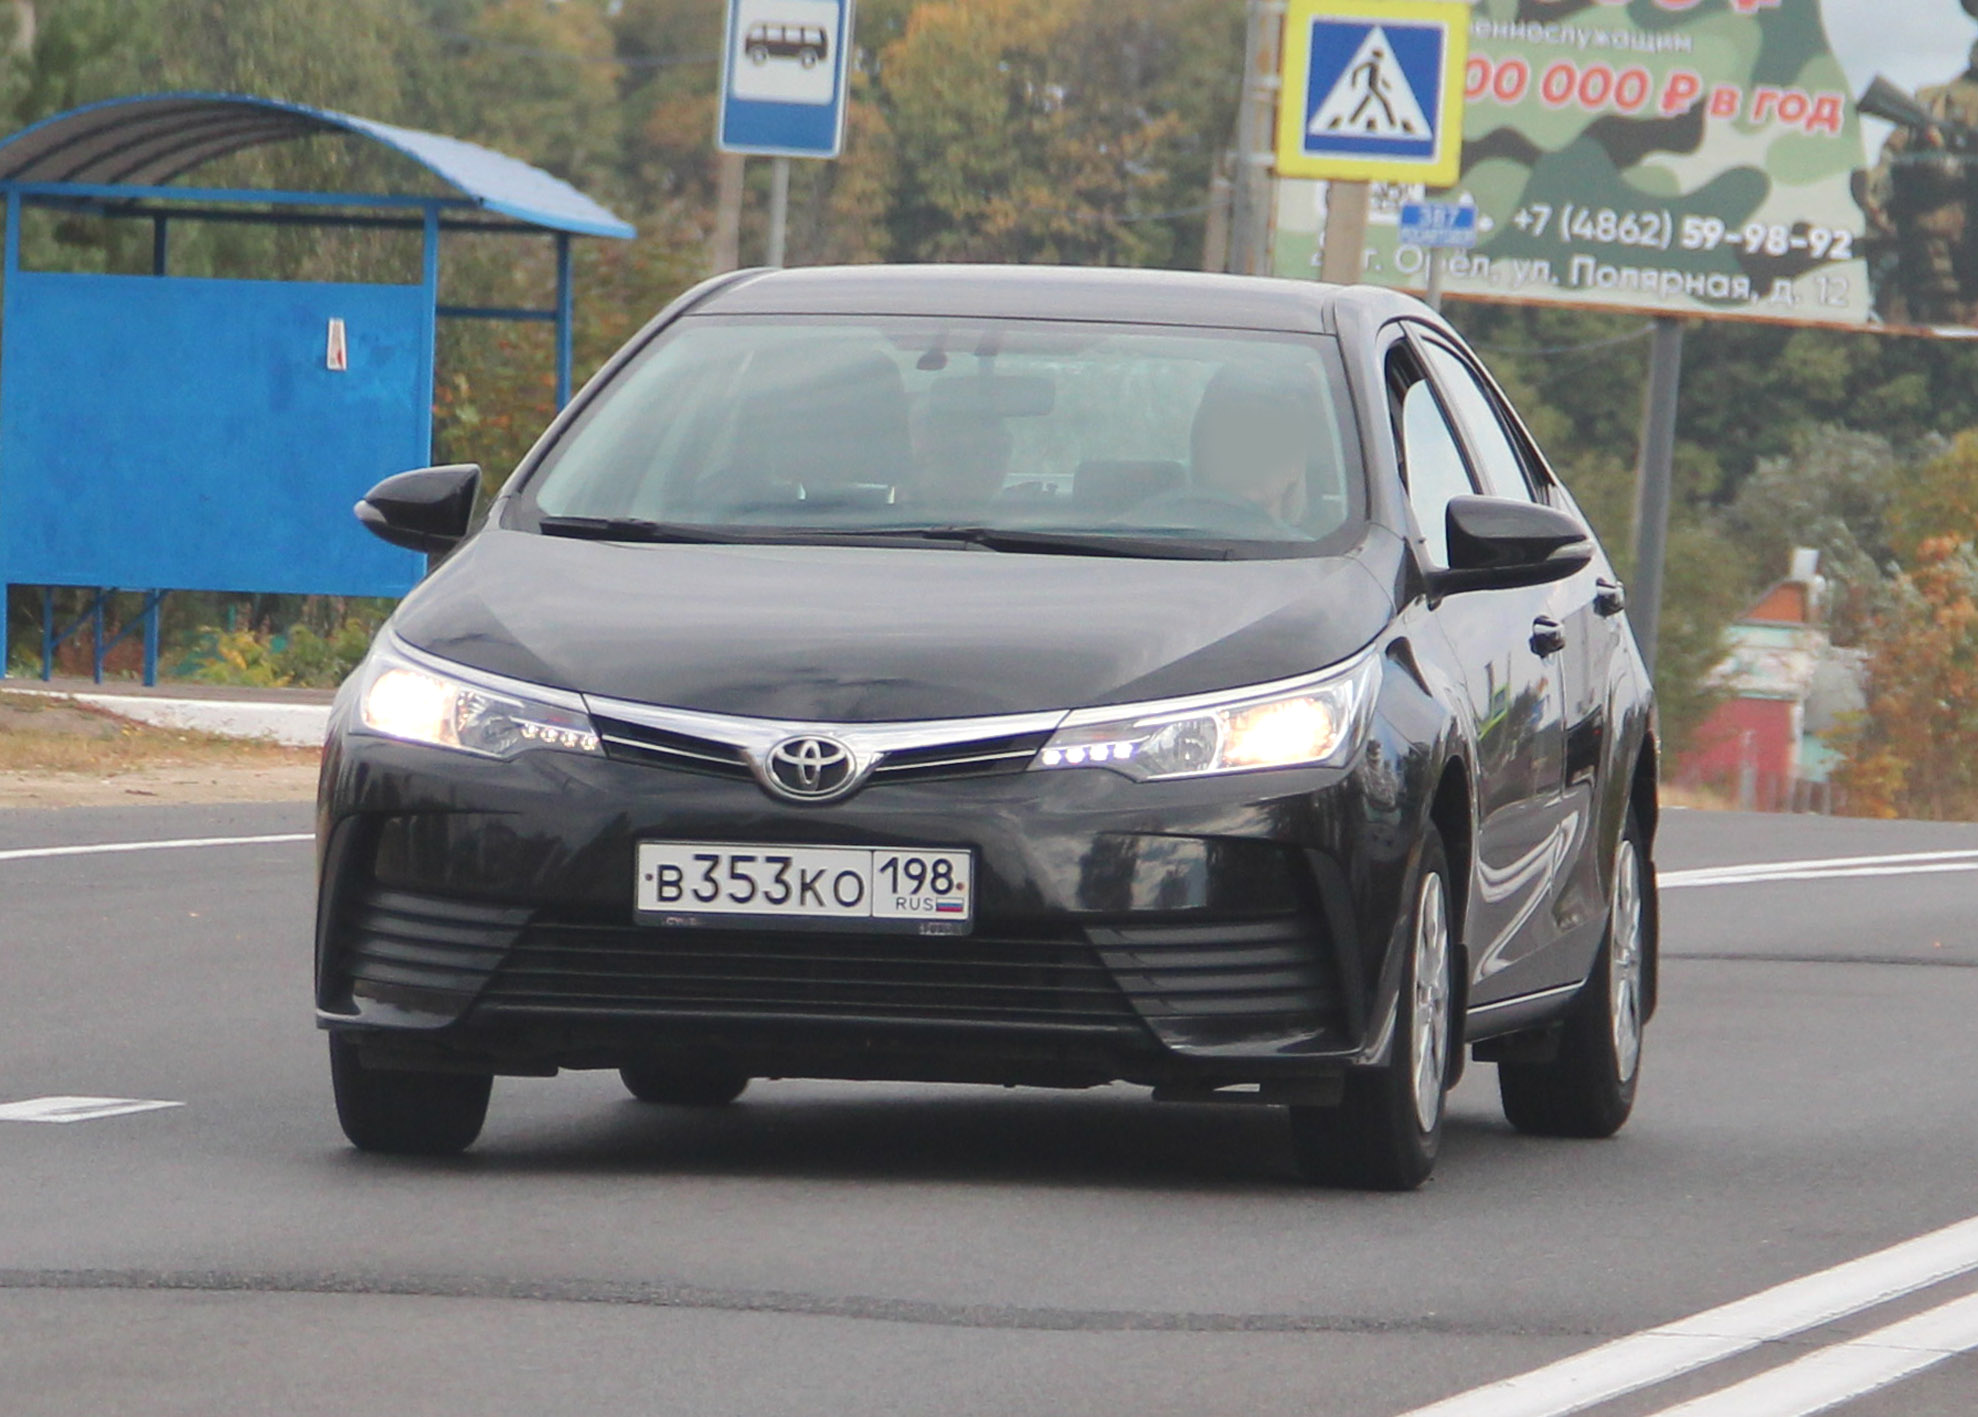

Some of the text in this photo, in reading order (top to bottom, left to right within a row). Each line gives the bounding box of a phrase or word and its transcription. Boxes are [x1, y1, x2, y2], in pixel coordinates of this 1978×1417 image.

[1472, 19, 1692, 54] еннослужащим
[1541, 63, 1649, 111] 000
[1754, 90, 1843, 132] год
[1513, 202, 1853, 260] +7 (4862) 59-98-92
[1512, 258, 1560, 288] ул.
[1571, 254, 1760, 304] Полярная,
[1815, 276, 1849, 307] 12
[656, 853, 954, 908] В353КО 198
[896, 896, 934, 912] RUS
